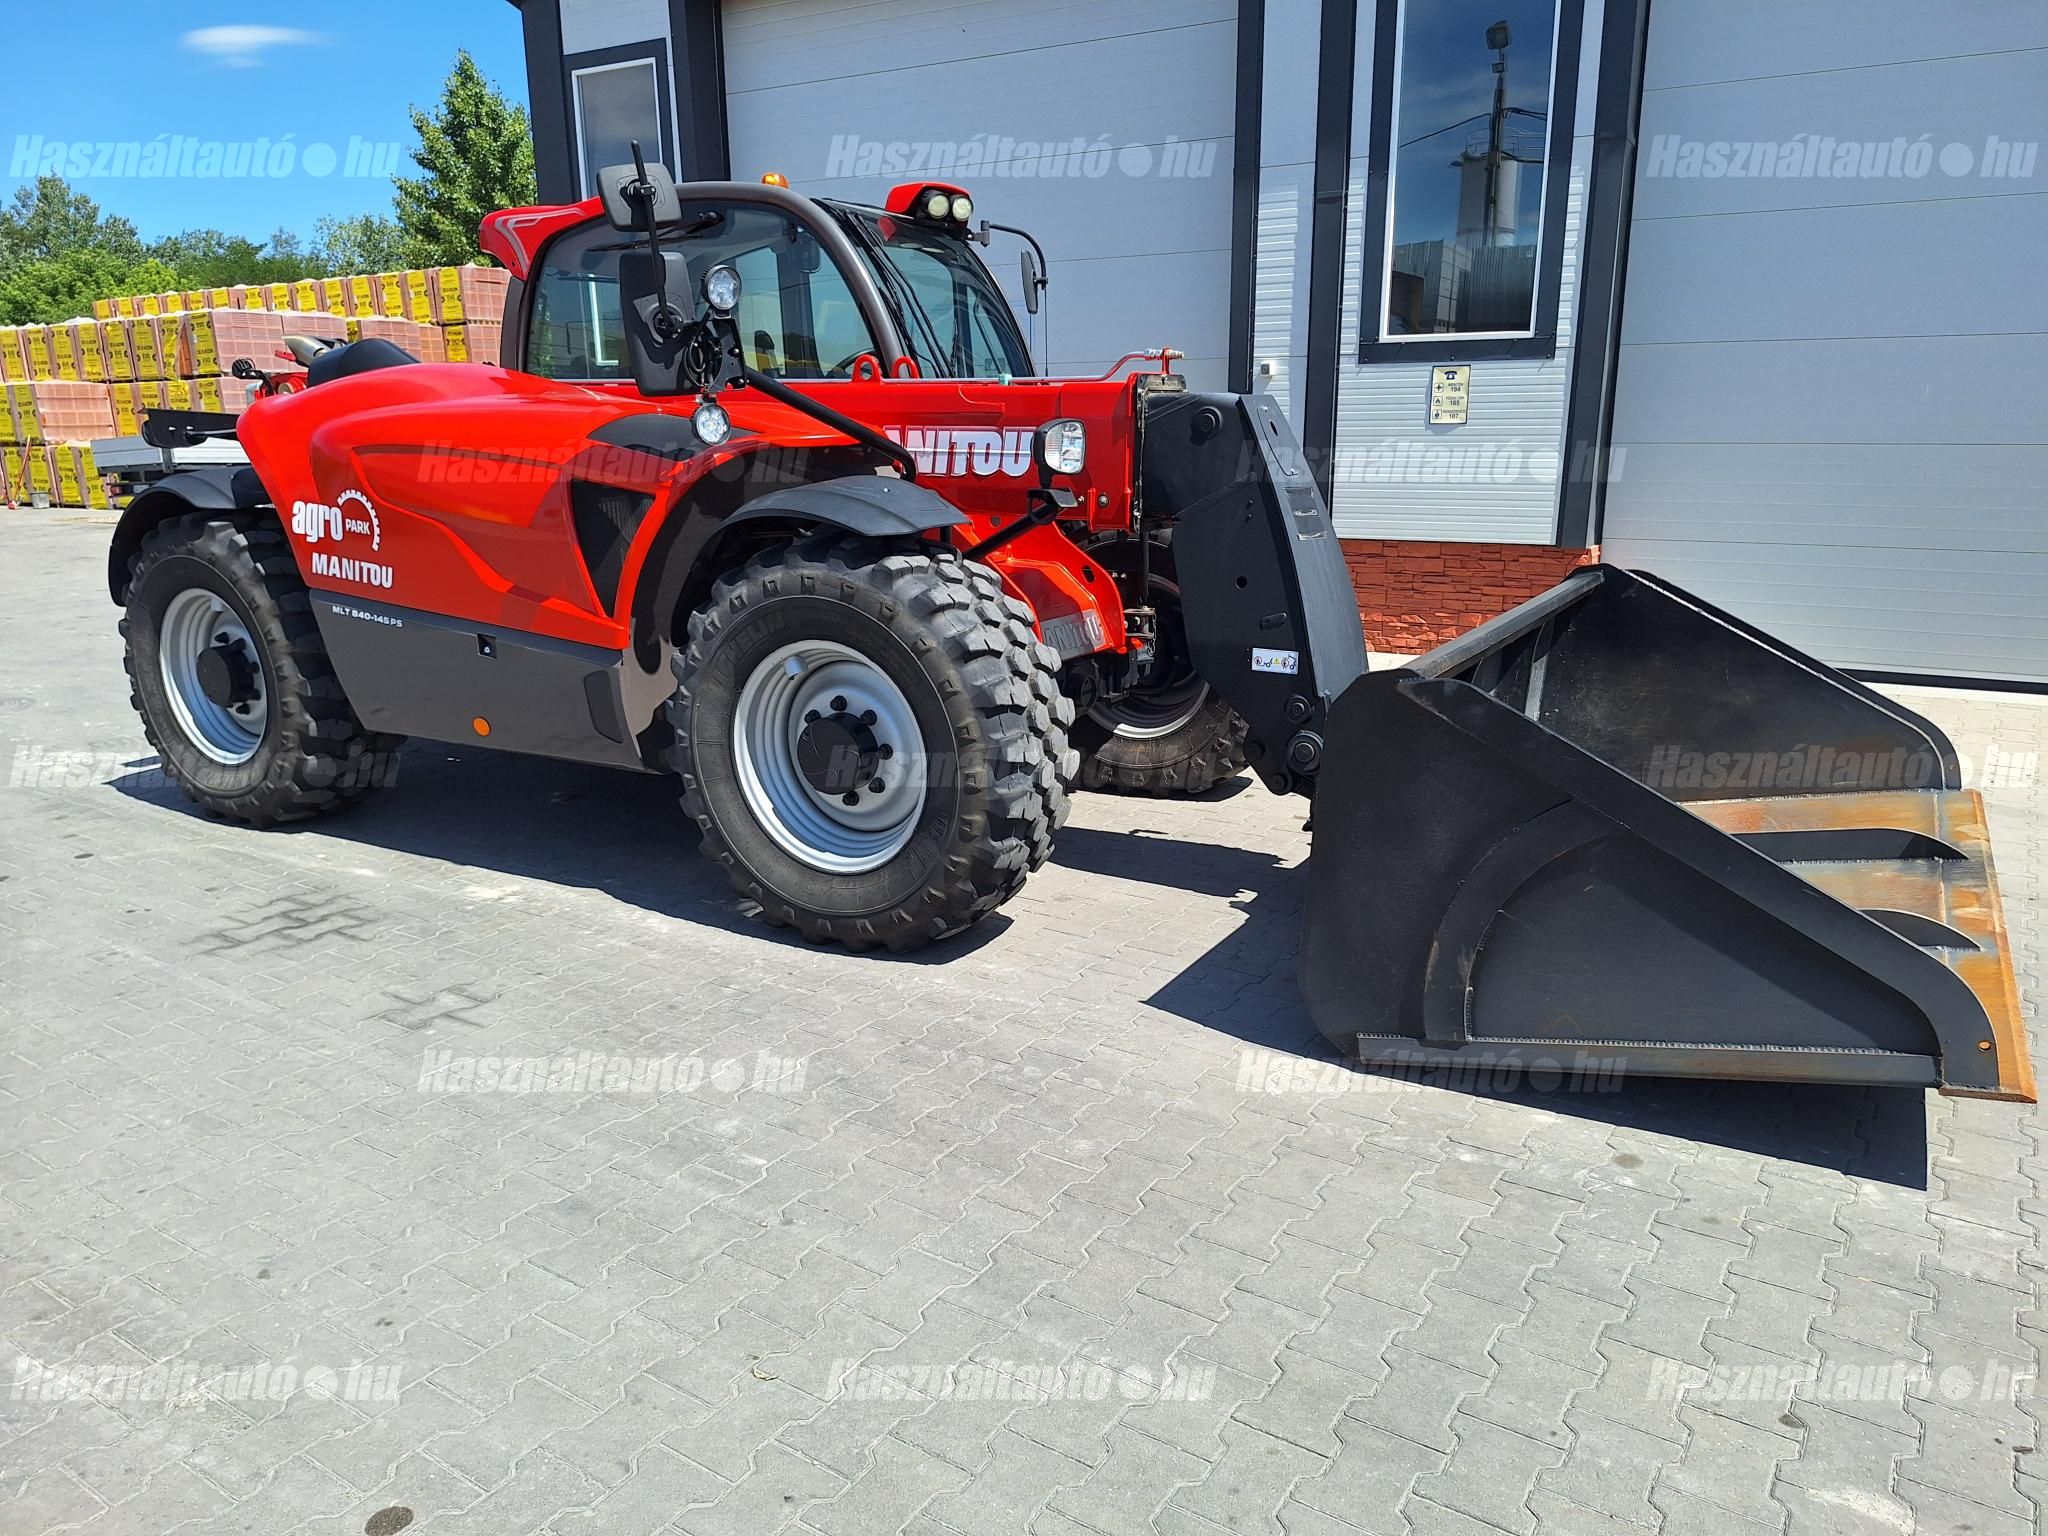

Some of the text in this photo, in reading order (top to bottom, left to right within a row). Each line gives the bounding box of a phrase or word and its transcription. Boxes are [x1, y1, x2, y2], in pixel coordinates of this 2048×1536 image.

[883, 425, 1037, 477] NITOU
[291, 500, 371, 543] agro PARK
[312, 552, 394, 589] MANITOU
[332, 605, 350, 616] MLT
